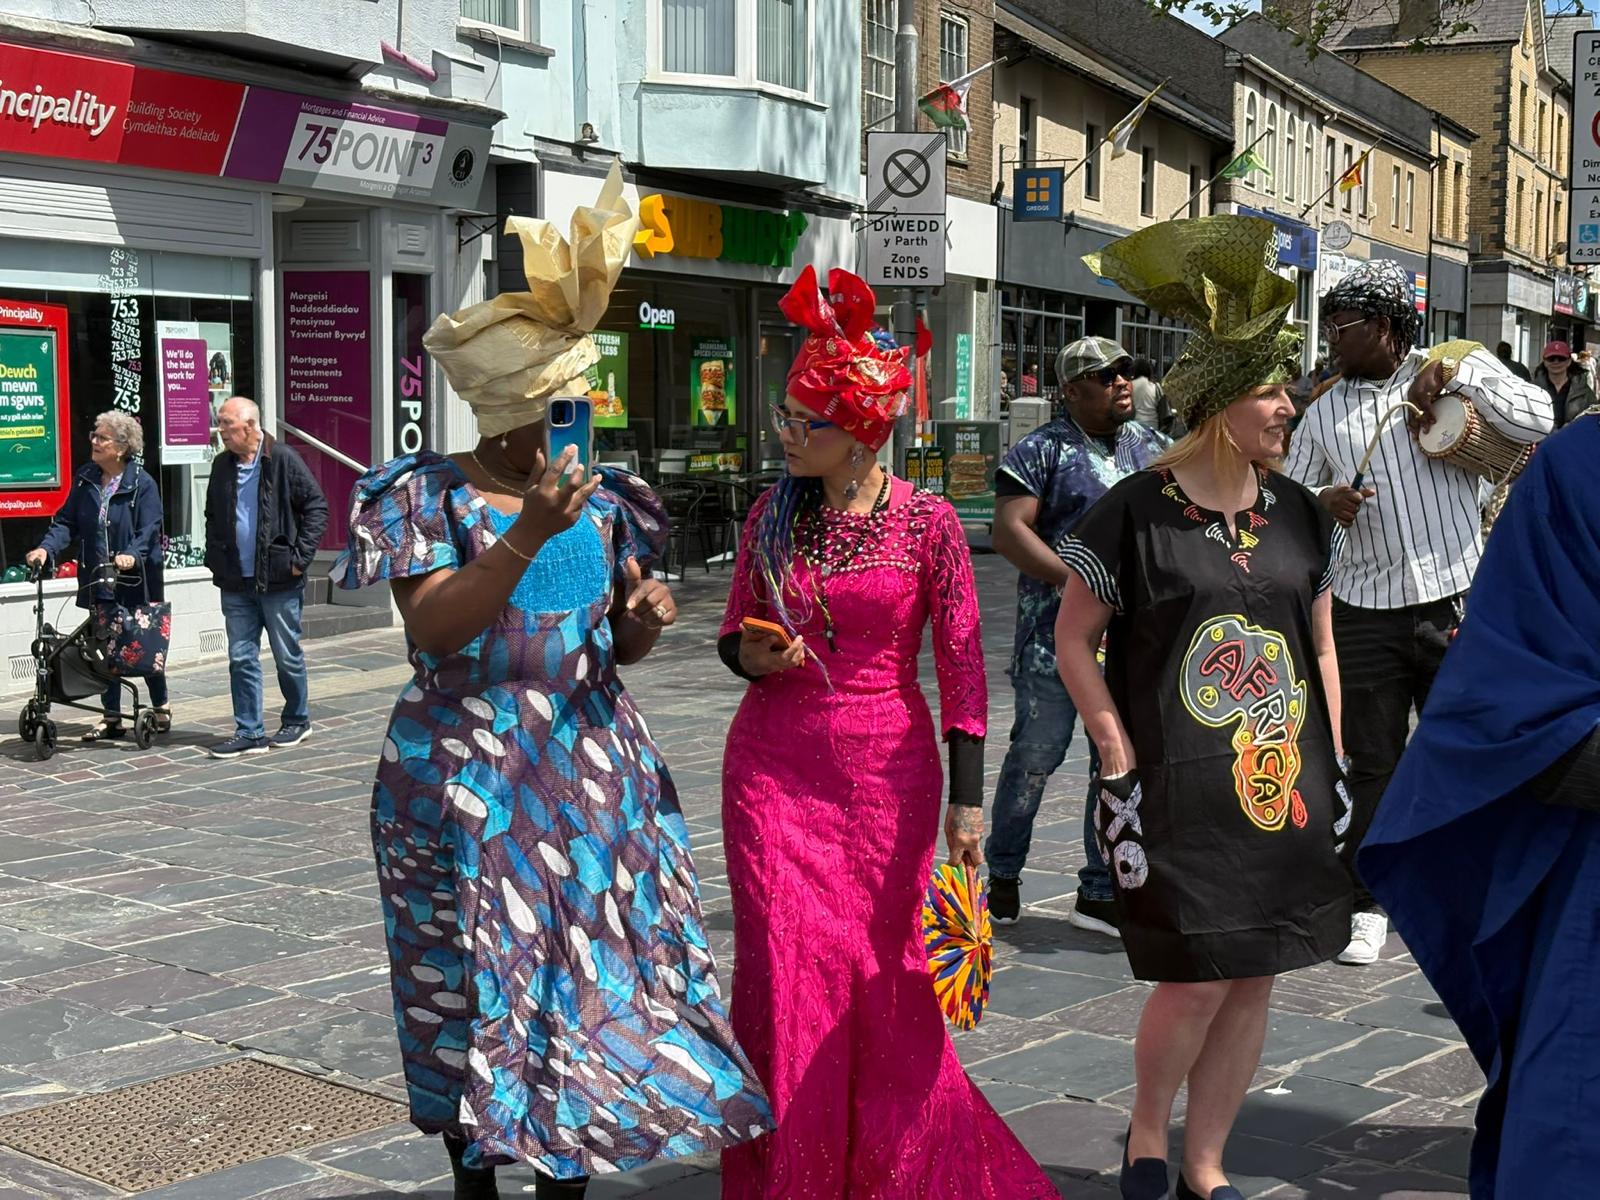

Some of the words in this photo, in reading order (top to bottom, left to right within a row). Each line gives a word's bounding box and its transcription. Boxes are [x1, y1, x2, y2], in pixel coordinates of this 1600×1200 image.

[1584, 72, 1598, 81] PE
[0, 80, 116, 137] ncipality
[126, 100, 165, 120] Building
[167, 107, 202, 123] Society
[301, 102, 331, 115] Mortgages
[332, 108, 343, 117] and
[343, 109, 368, 121] Financial
[367, 113, 386, 124] Advice
[122, 117, 177, 137] Cymdeithas
[179, 126, 220, 143] Adeiladu
[873, 220, 939, 232] DIWEDD
[883, 238, 890, 247] y
[895, 236, 928, 246] Parth
[891, 253, 921, 263] Zone
[883, 266, 929, 279] ENDS
[290, 292, 328, 302] Morgeisi
[110, 298, 139, 318] 75.3
[290, 305, 359, 314] Buddsoddiadau
[639, 301, 675, 327] Open
[290, 317, 335, 327] Pensiynau
[290, 330, 332, 340] Yswiriant
[334, 330, 366, 341] Bywyd
[598, 334, 620, 345] FRESH
[166, 350, 184, 359] We'll
[185, 350, 194, 359] do
[601, 345, 618, 356] LESS
[167, 360, 179, 369] the
[180, 360, 195, 369] hard
[290, 356, 338, 366] Mortgages
[0, 363, 37, 378] Dewch
[167, 371, 184, 380] work
[186, 371, 195, 380] for
[290, 368, 343, 377] Investments
[2, 381, 37, 392] mewn
[290, 381, 329, 390] Pensions
[11, 395, 45, 410] sgwrs
[113, 386, 141, 413] 75.3
[290, 393, 306, 402] Life
[308, 394, 353, 402] Assurance
[956, 433, 980, 441] NOM
[1200, 639, 1288, 806] AFRICA
